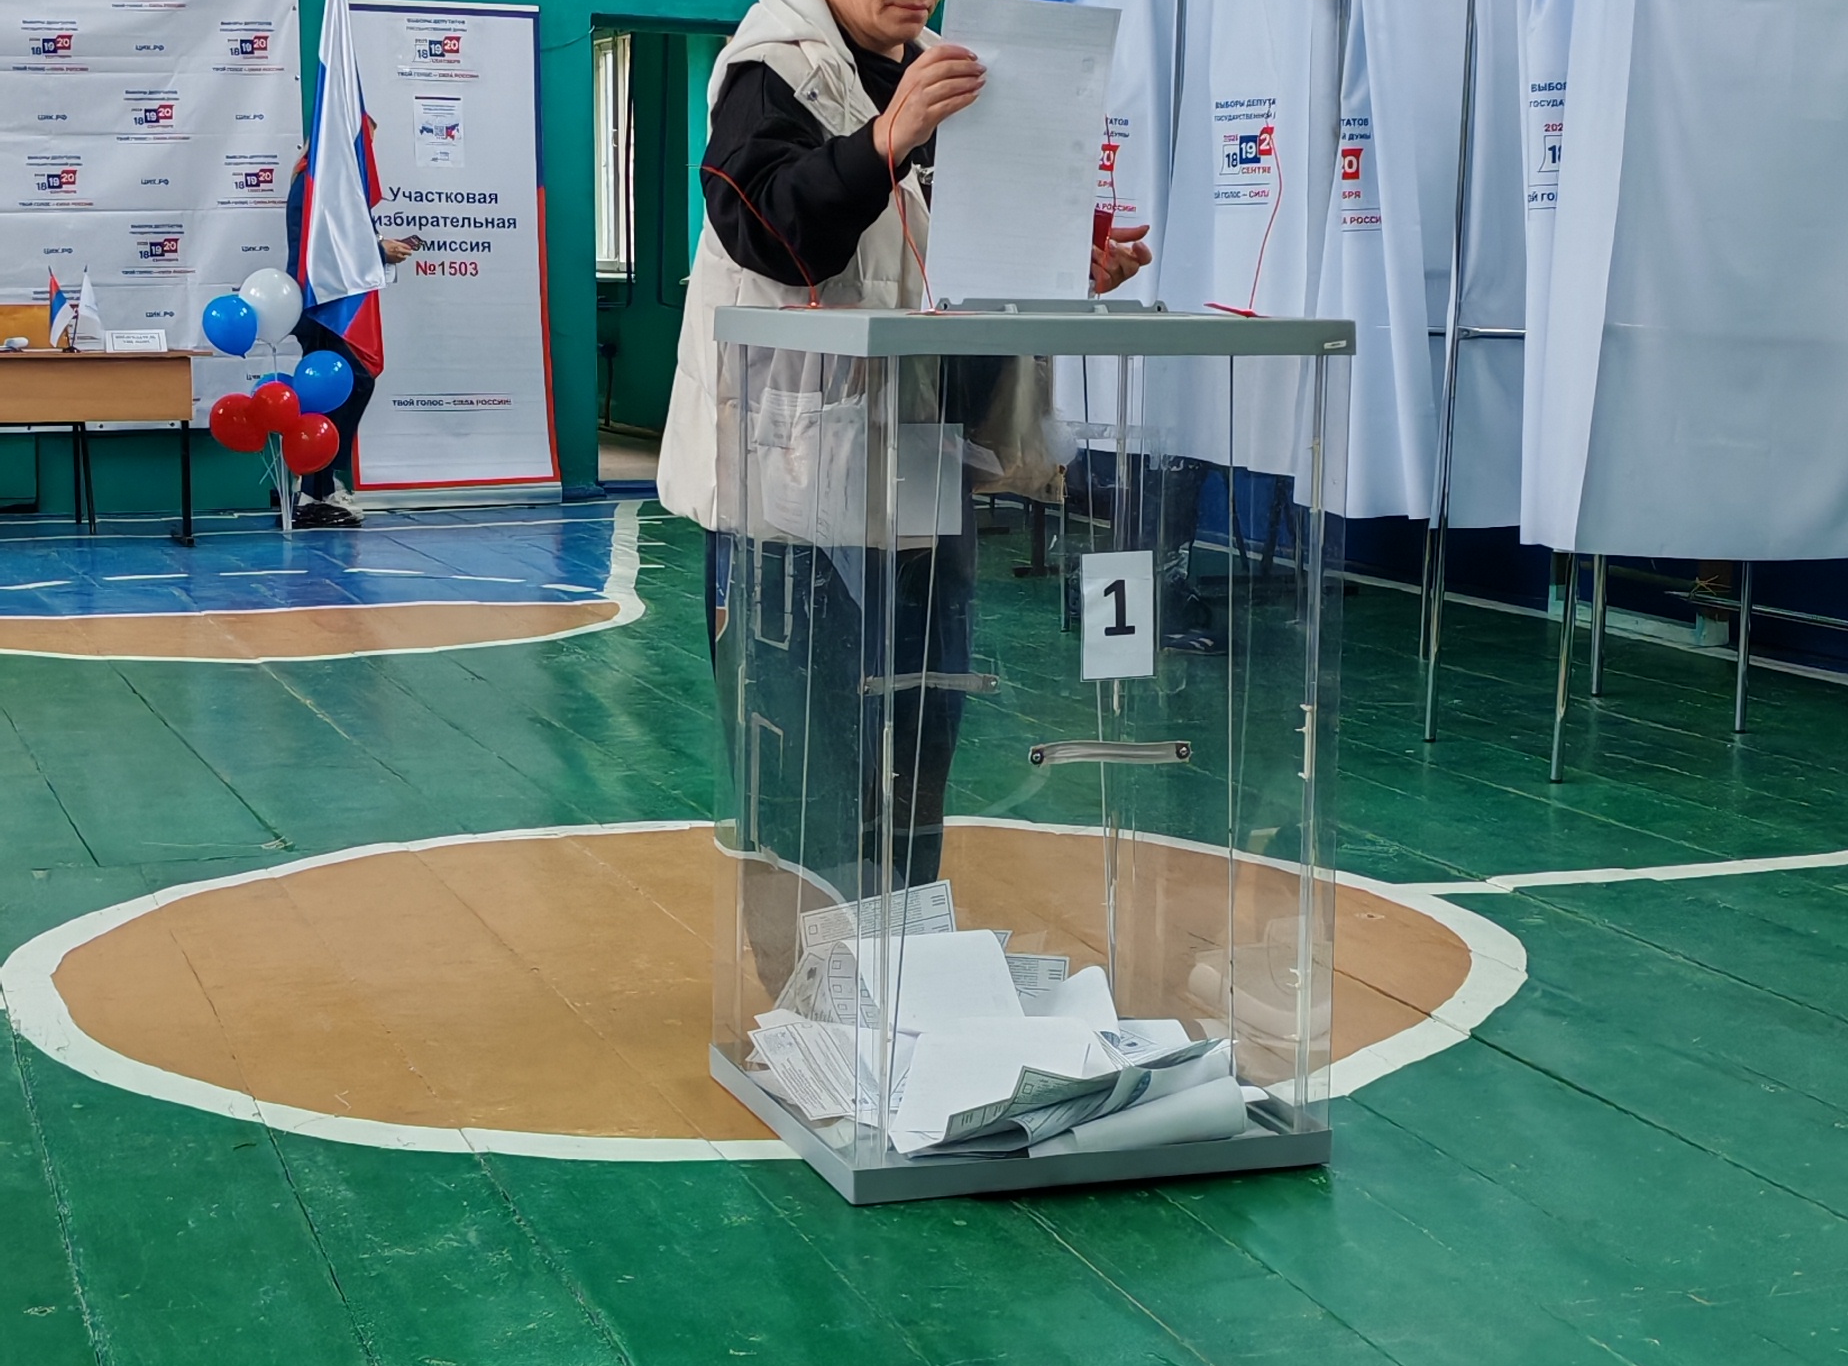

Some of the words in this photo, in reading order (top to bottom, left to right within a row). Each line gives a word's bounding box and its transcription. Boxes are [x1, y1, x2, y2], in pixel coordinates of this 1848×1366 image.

[56, 38, 70, 47] 20
[417, 49, 429, 59] 18
[430, 43, 442, 55] 19
[444, 39, 459, 50] 20
[133, 116, 145, 125] 18
[146, 111, 157, 121] 19
[158, 107, 172, 116] 20
[1225, 152, 1239, 168] 18
[1240, 141, 1257, 159] 19
[35, 182, 47, 190] 18
[61, 173, 75, 182] 20
[258, 171, 272, 181] 20
[388, 186, 499, 204] Участковая
[1541, 192, 1558, 202] ГО
[373, 211, 517, 231] избирательная
[139, 250, 150, 259] 18
[151, 245, 162, 255] 19
[163, 241, 177, 250] 20
[413, 239, 492, 252] миссия
[415, 260, 479, 276] №1503
[392, 398, 414, 407] ТВОЙ
[1103, 579, 1136, 636] 1
